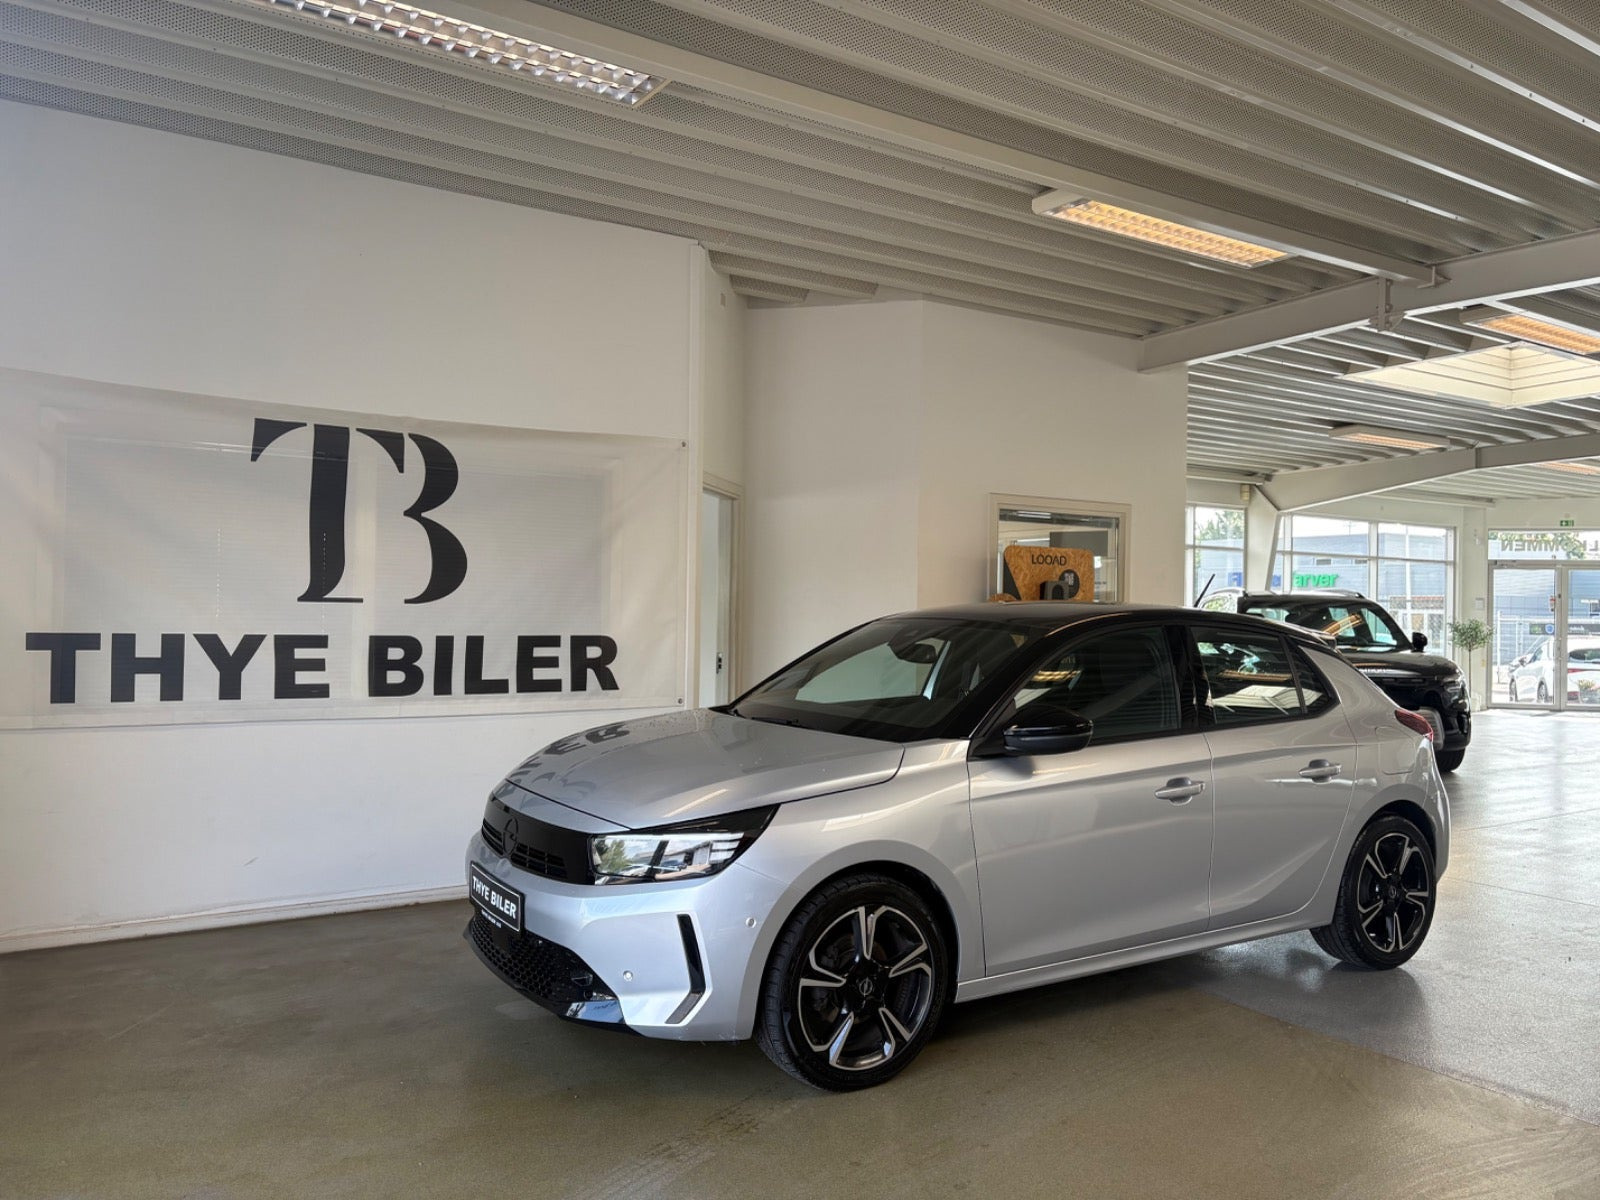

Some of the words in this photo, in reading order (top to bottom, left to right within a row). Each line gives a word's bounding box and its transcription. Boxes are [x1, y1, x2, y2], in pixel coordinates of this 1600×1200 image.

[1292, 571, 1339, 588] arver
[25, 632, 330, 704] THYE
[367, 634, 620, 697] BILER
[473, 876, 490, 901] THYE
[490, 890, 517, 919] BILER
